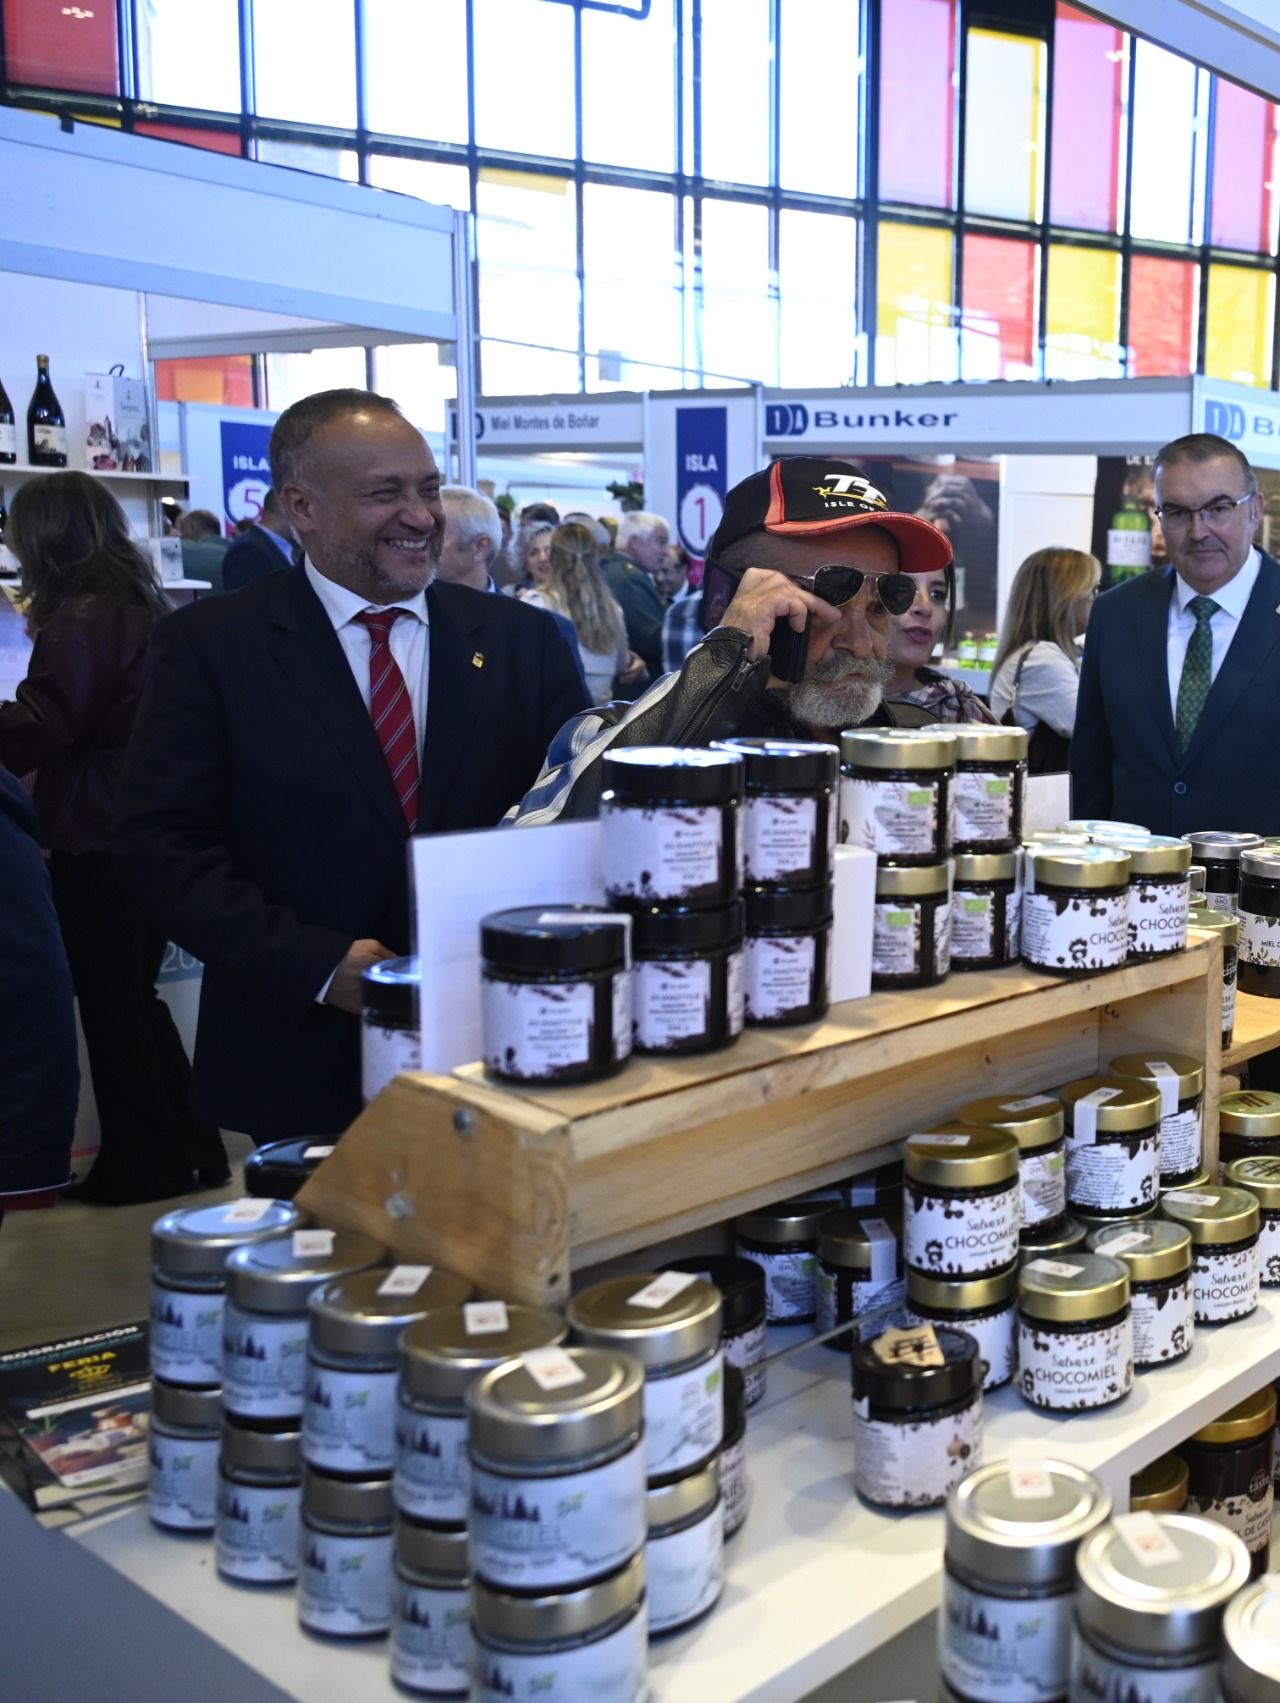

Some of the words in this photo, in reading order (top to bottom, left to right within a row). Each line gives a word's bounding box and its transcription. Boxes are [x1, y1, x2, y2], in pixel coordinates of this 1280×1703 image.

[513, 415, 550, 431] Montes
[553, 414, 566, 430] de
[568, 413, 600, 430] Boñar
[815, 410, 959, 427] Bunker
[234, 454, 270, 471] ISLA
[685, 454, 719, 471] ISLA
[243, 488, 264, 522] 5
[695, 497, 706, 541] 1
[1090, 930, 1127, 945] CHOCO
[1261, 940, 1276, 948] MIEL
[0, 1326, 138, 1361] ROGRAMACIÓN
[48, 1352, 118, 1373] FERIA
[1034, 1364, 1118, 1385] CHOCOMIEL
[1244, 1525, 1255, 1536] DE
